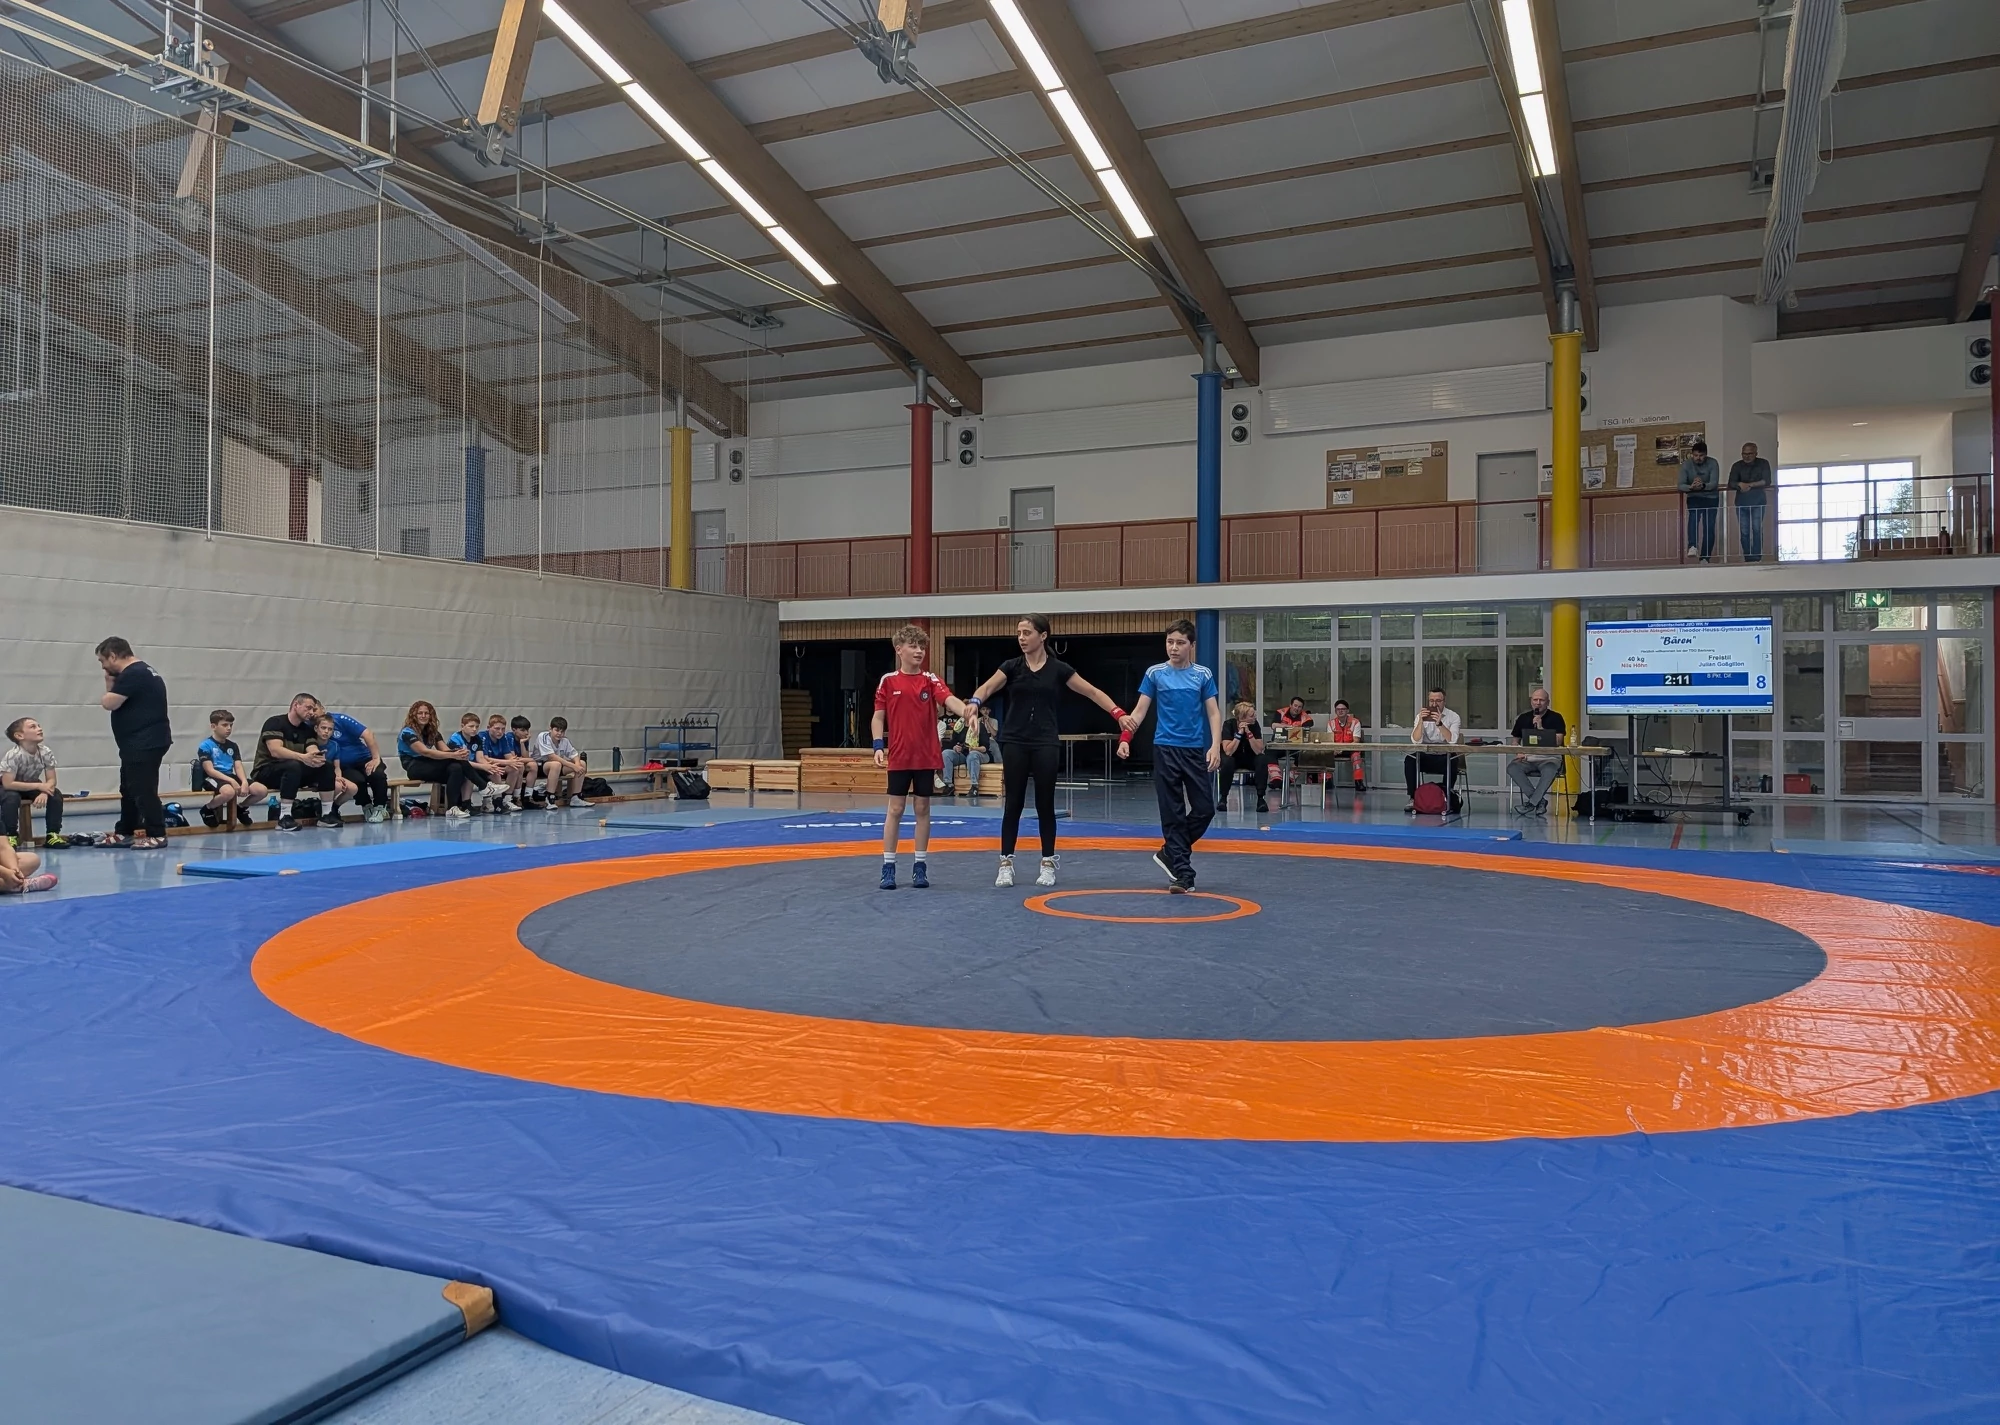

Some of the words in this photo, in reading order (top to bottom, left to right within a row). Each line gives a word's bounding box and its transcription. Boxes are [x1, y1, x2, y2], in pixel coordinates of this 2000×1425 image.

[1602, 418, 1619, 426] TSG
[1621, 415, 1670, 425] Infoationen
[1596, 637, 1603, 648] 0
[1754, 634, 1761, 645] 1
[1594, 677, 1604, 691] 0
[1664, 675, 1690, 685] 2:11
[1756, 675, 1767, 689] 8
